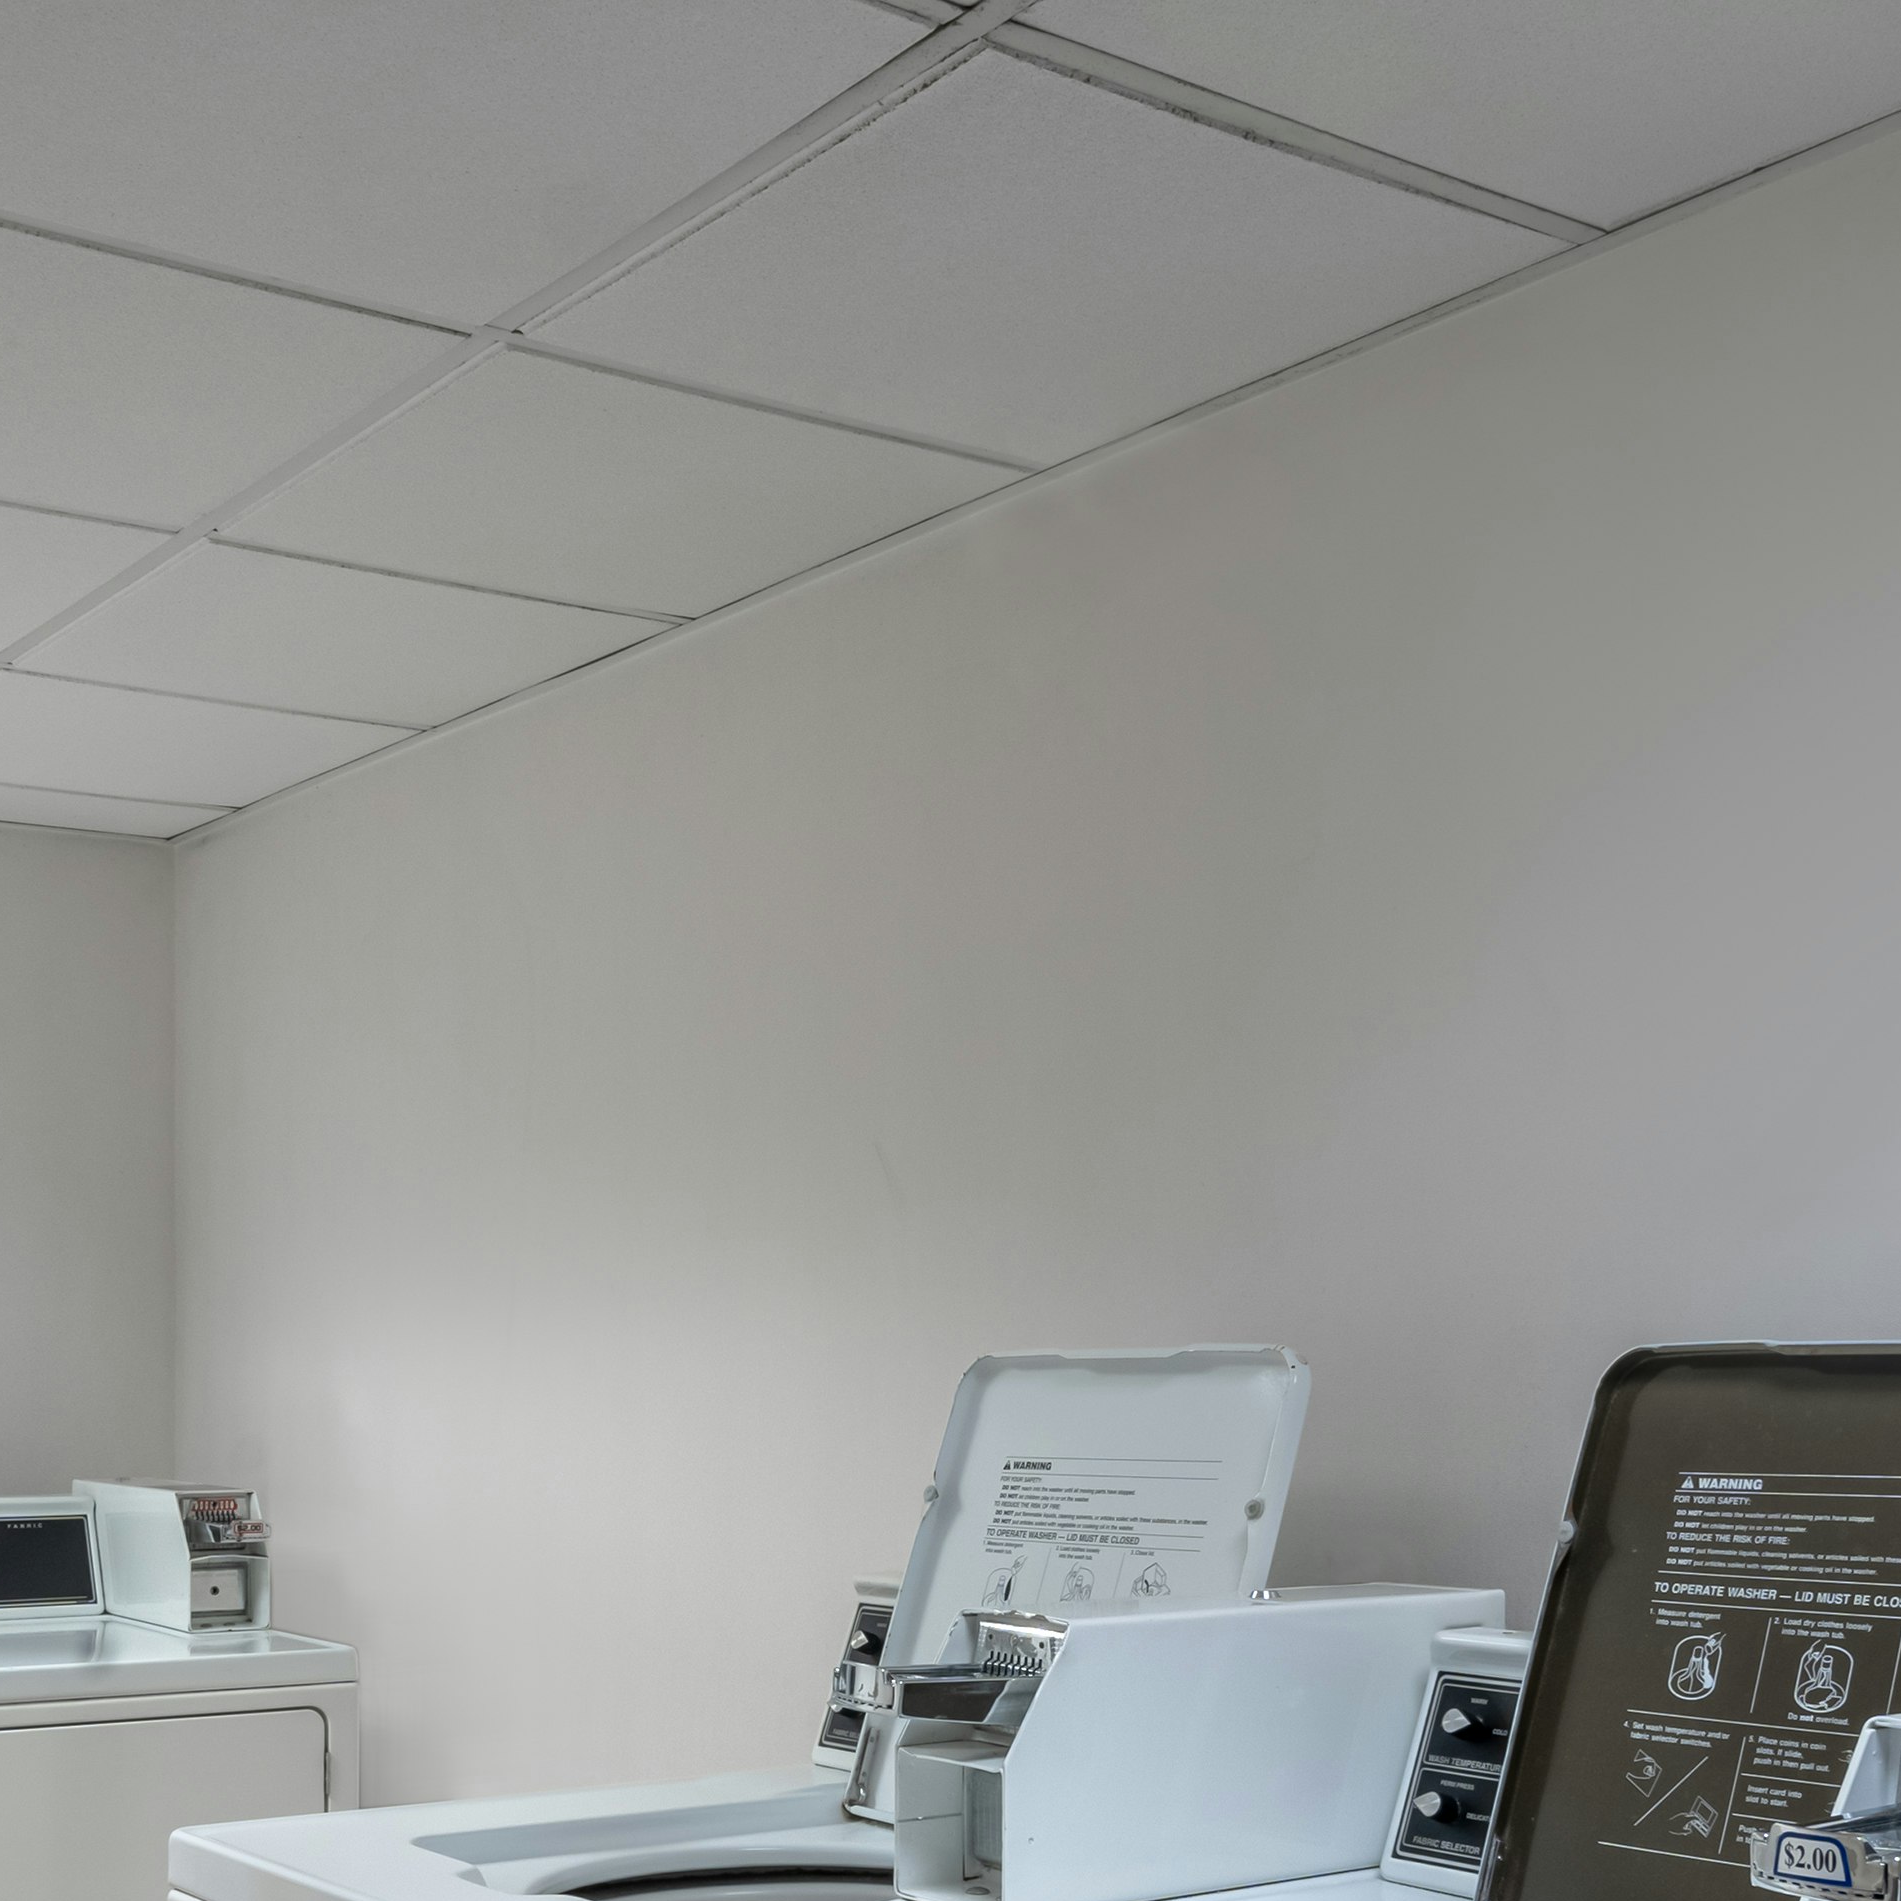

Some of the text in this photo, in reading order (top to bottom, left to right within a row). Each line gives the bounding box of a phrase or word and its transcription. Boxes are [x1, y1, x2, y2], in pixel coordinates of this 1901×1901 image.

[1013, 1461, 1052, 1470] WARNING
[1699, 1478, 1763, 1490] WARNING
[1673, 1495, 1751, 1505] FOR YOUR SAFETY:
[987, 1528, 1140, 1544] TO OPERATE WASHER LID MUST BE CLOSED
[1666, 1531, 1790, 1545] TO REDUCE THE RISK OF FIRE:
[1654, 1581, 1670, 1593] TO
[1671, 1583, 1725, 1597] OPERATE
[1728, 1587, 1778, 1600] WASHER
[1794, 1591, 1814, 1602] LID
[1816, 1592, 1852, 1605] MUST
[1853, 1594, 1871, 1606] BE
[1451, 1758, 1503, 1772] TEMPERATUR
[1413, 1835, 1480, 1855] FABRIC SELECTOR
[1784, 1843, 1836, 1873] $2.00
